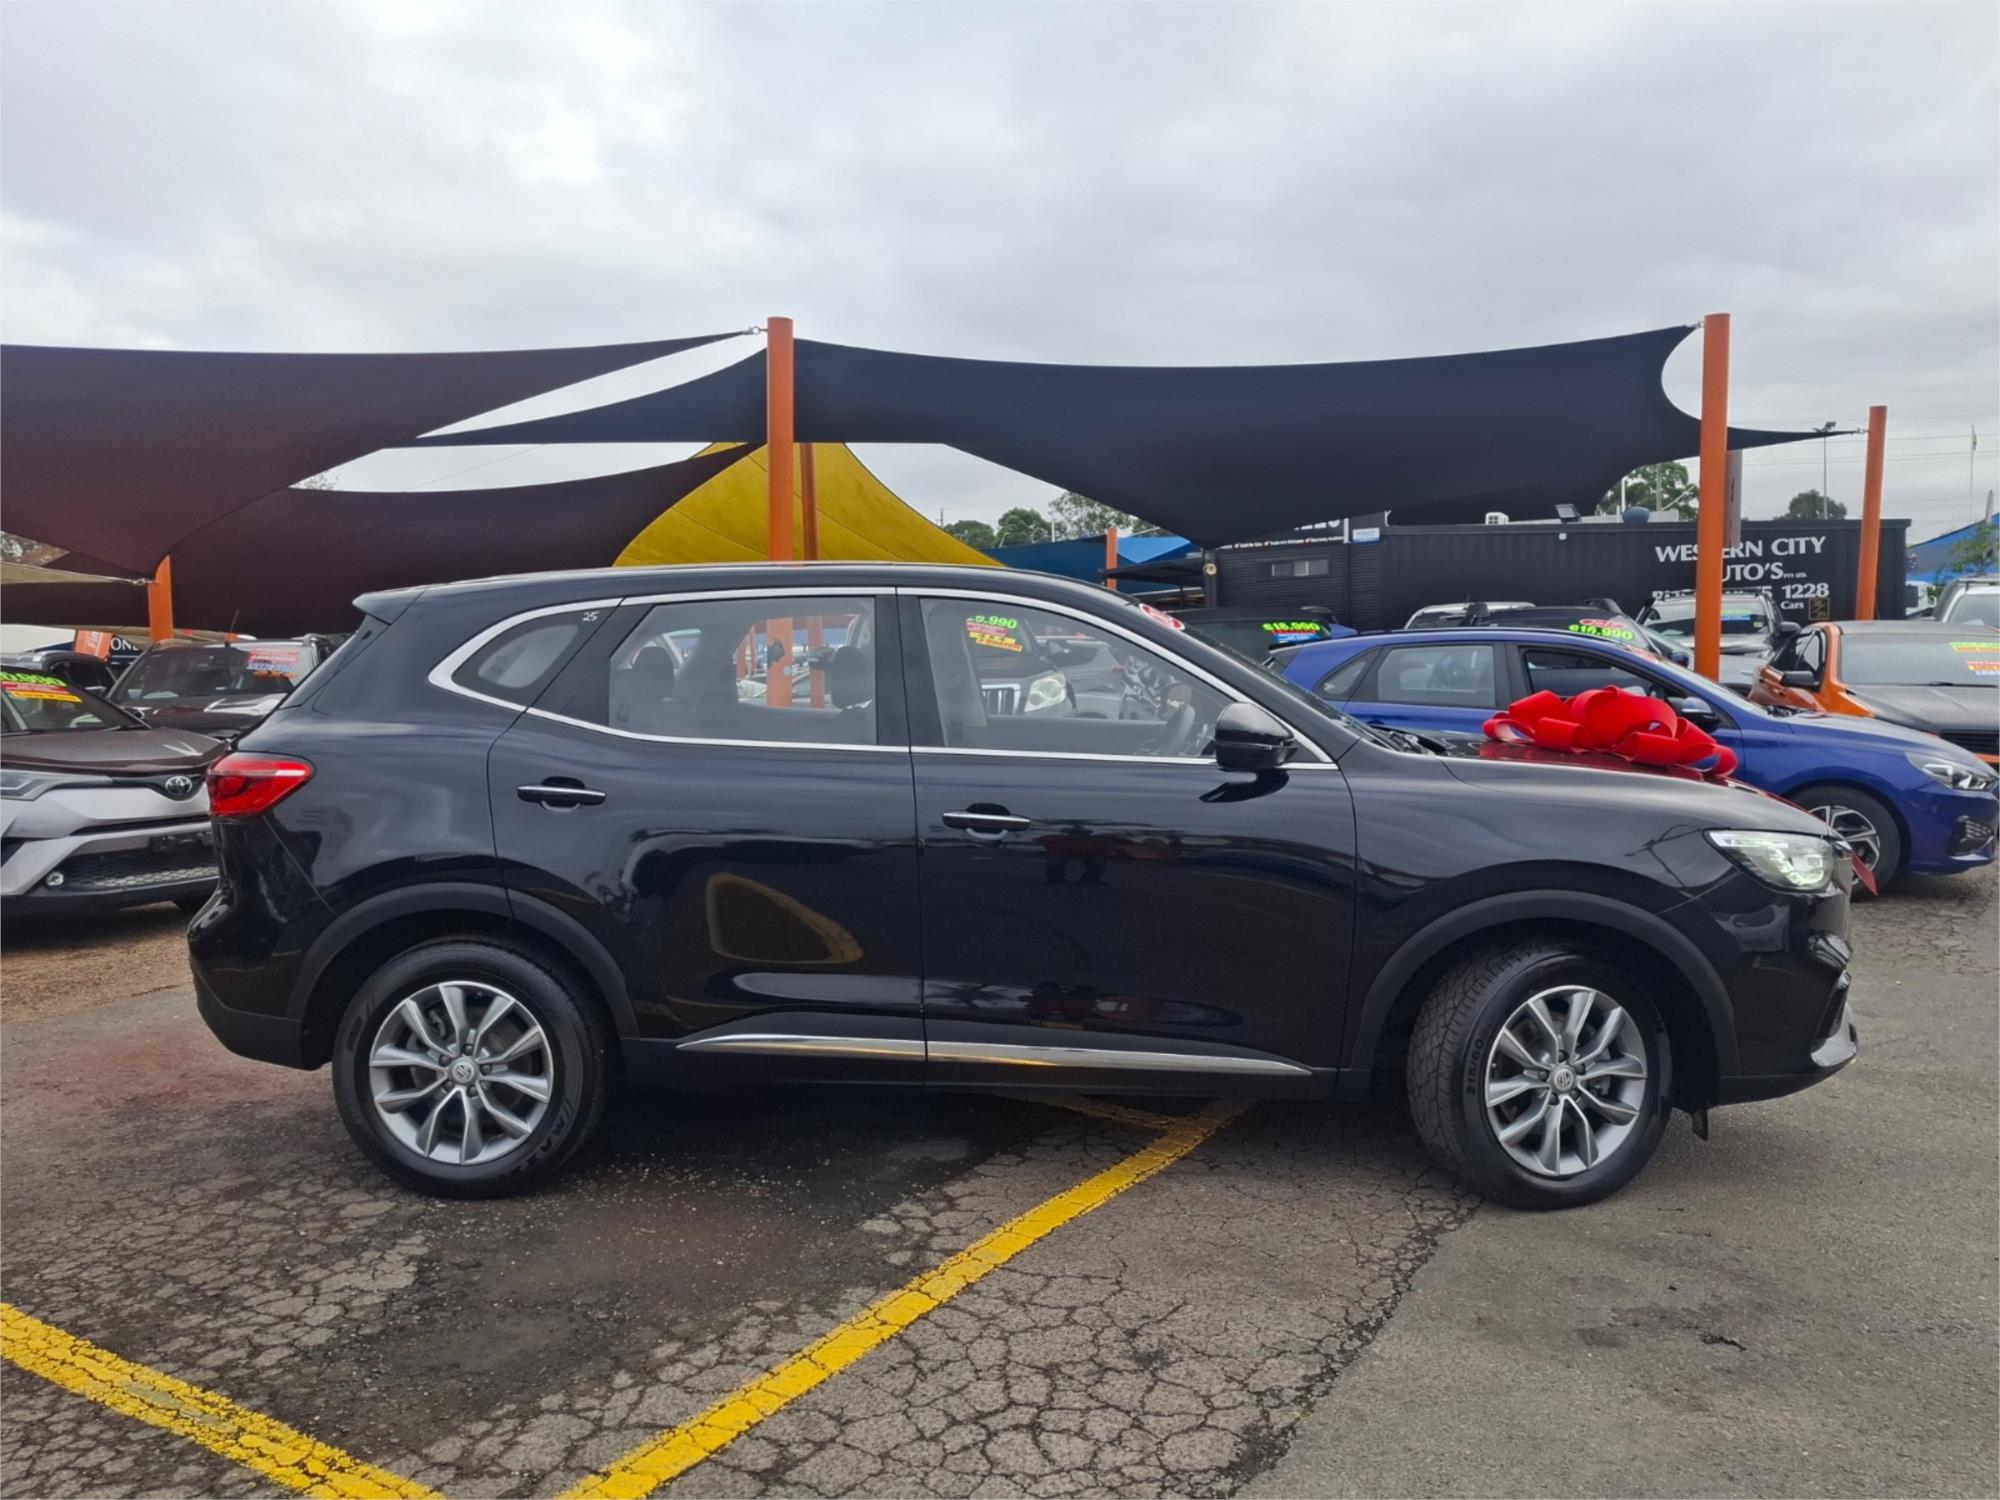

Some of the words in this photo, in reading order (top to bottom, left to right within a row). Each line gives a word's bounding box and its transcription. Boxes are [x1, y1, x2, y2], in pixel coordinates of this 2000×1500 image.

[1655, 540, 1763, 563] WESERN
[1771, 536, 1826, 556] CITY
[1722, 562, 1784, 582] UTO'S
[1781, 583, 1830, 599] 1228
[1780, 600, 1804, 610] Cars
